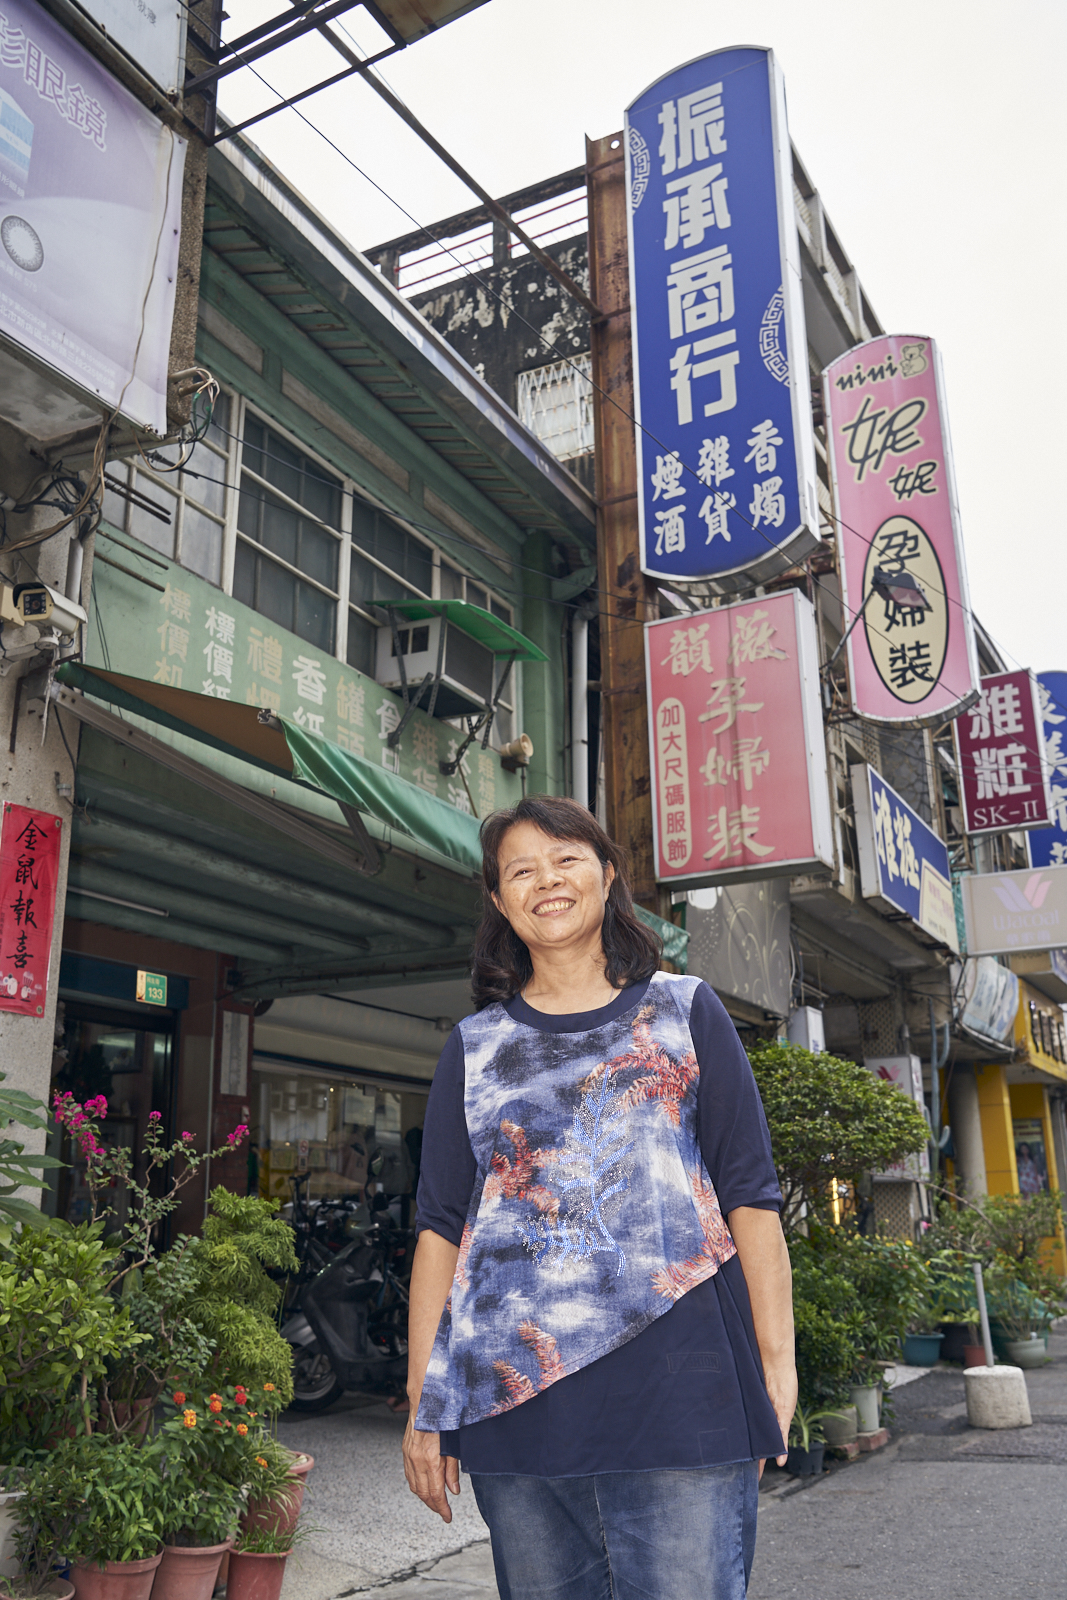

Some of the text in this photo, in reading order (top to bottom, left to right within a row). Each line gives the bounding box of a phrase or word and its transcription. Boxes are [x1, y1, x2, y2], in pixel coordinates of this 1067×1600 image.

[657, 81, 741, 427] 振承商行
[835, 353, 898, 391] nini
[650, 447, 687, 557] 煙酒
[697, 434, 737, 546] 雜貨
[744, 418, 787, 531] 香燭
[661, 704, 688, 863] 加大尺碼服飾
[973, 799, 1041, 827] SK-II
[6, 818, 48, 969] 金鼠報喜
[148, 987, 163, 1000] 133
